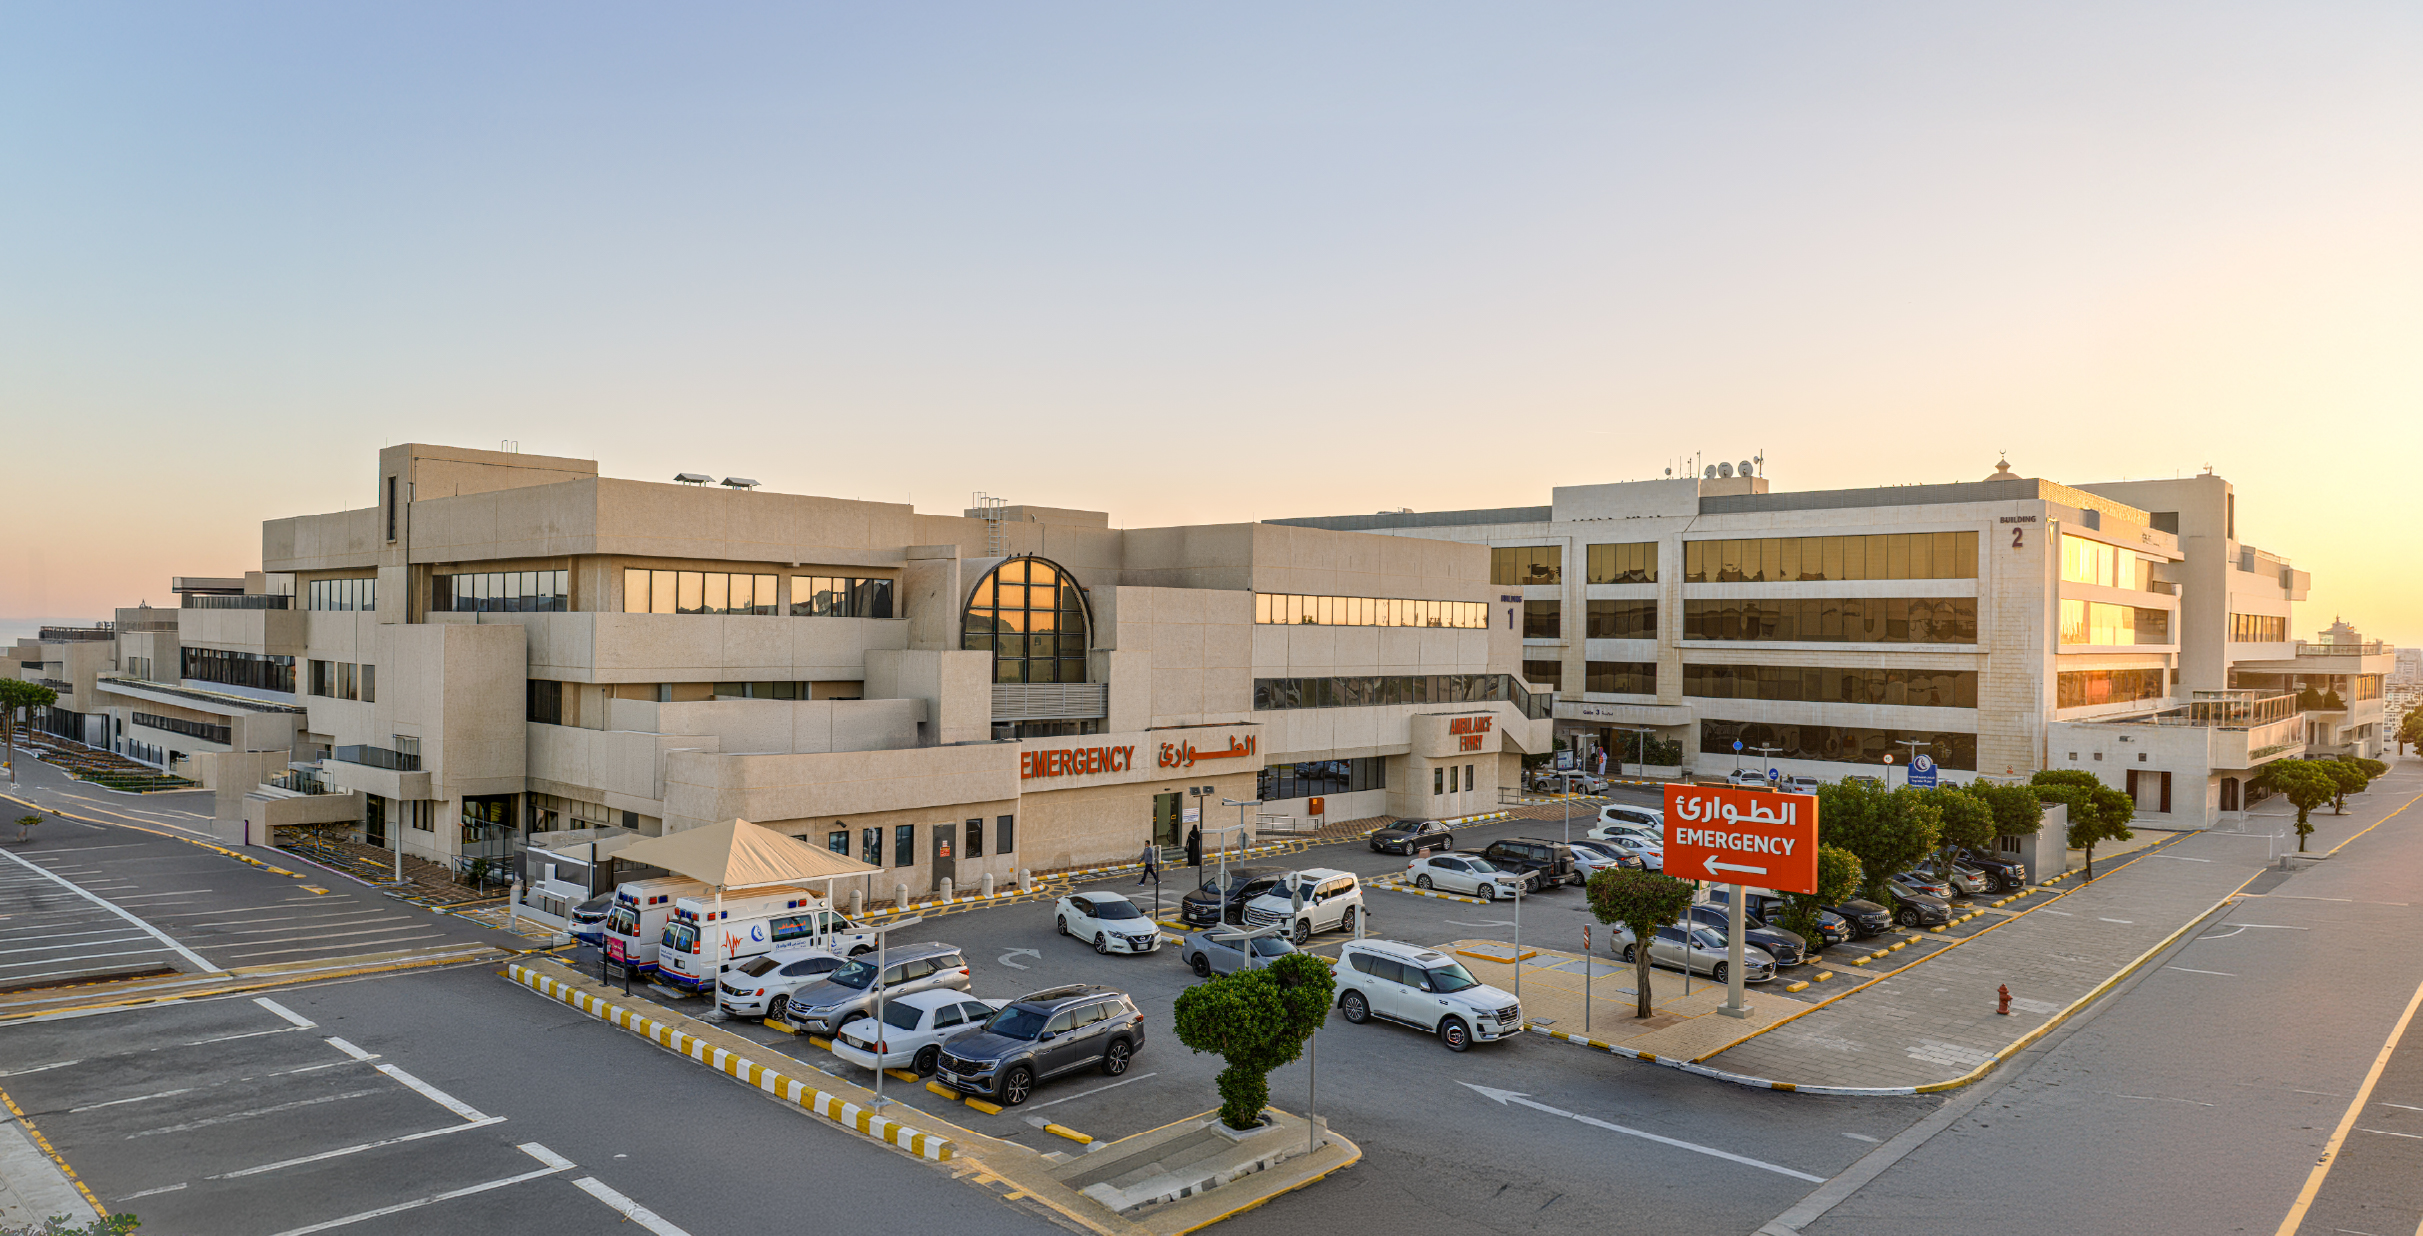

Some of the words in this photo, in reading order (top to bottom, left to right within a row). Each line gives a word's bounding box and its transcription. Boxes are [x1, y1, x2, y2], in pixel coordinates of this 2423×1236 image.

[2000, 515, 2036, 524] BUILDING
[2012, 527, 2023, 548] 2
[1507, 608, 1514, 630] 1
[1021, 745, 1135, 779] EMERGENCY
[1158, 734, 1257, 769] الطوارئ
[1675, 795, 1797, 826] الطوارئ
[1676, 827, 1796, 856] EMERGENCY
